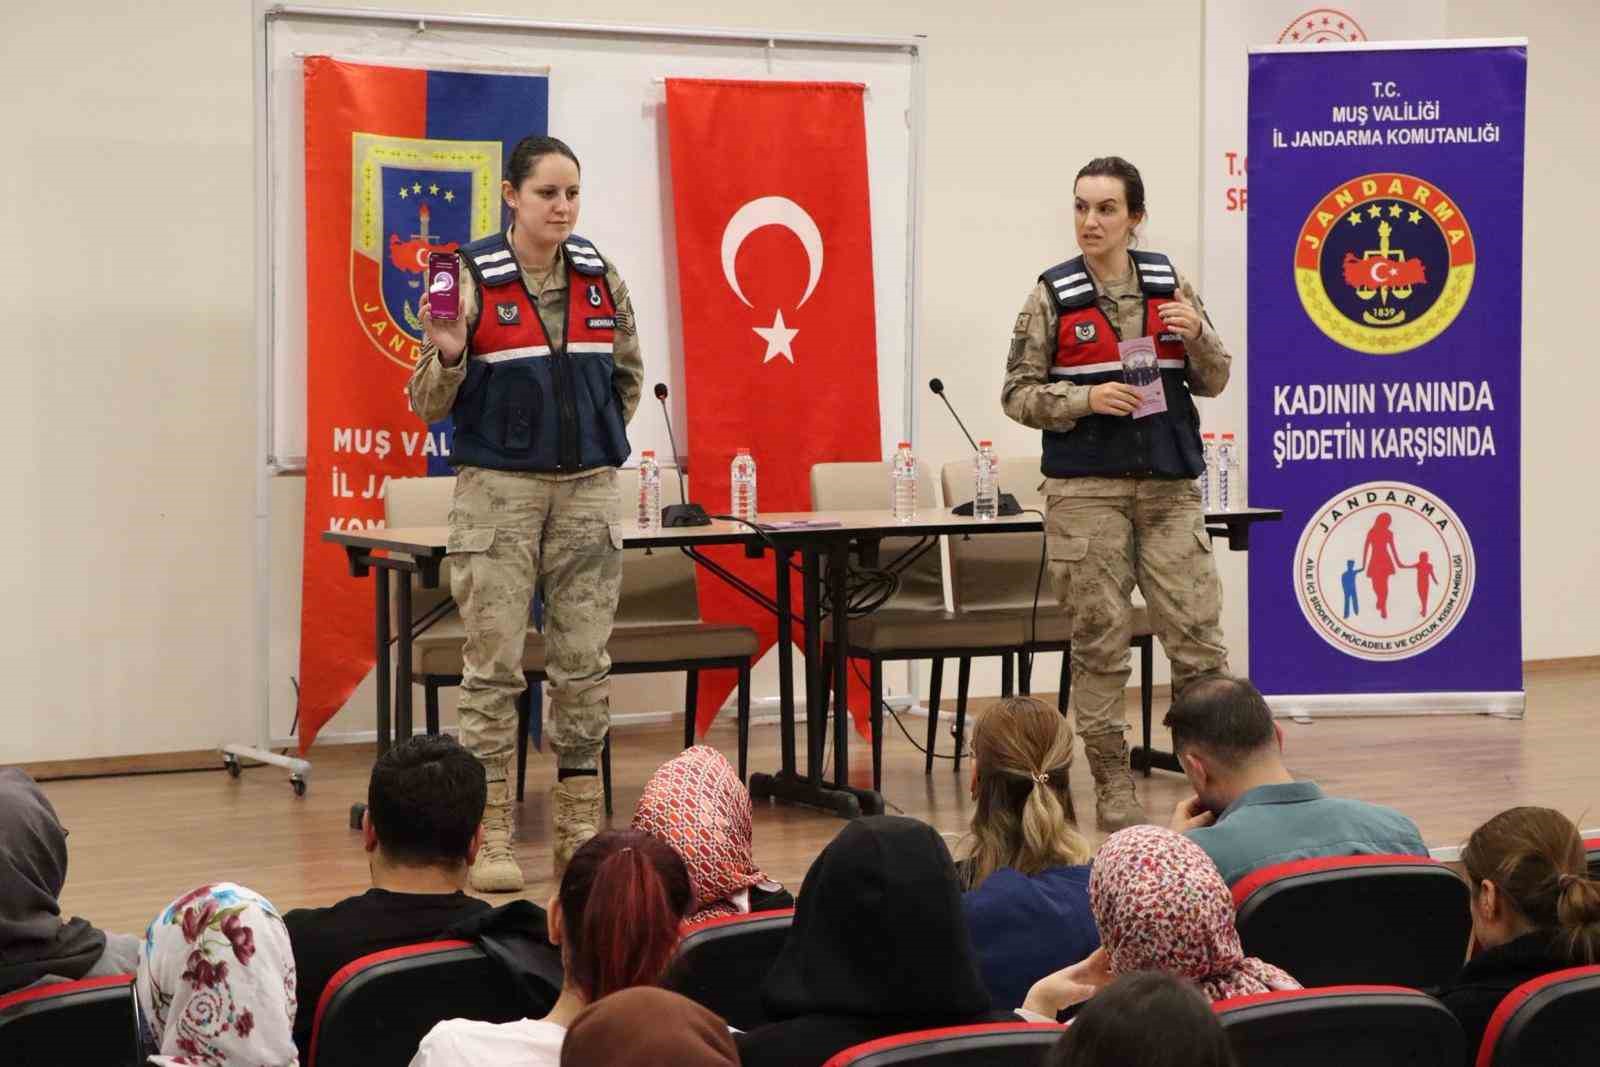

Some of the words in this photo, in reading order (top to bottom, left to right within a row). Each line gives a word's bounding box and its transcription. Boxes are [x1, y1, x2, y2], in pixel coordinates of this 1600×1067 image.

[1371, 81, 1401, 98] T.C.
[1333, 106, 1367, 126] MUŞ
[1373, 100, 1440, 121] VALİLİĞİ
[1273, 128, 1287, 148] İL
[1291, 131, 1383, 148] JANDARMA
[1387, 122, 1500, 145] KOMUTANLIĞI
[1305, 178, 1465, 250] JANDARMA
[1273, 383, 1376, 415] KADININ
[1382, 380, 1495, 413] YANINDA
[333, 427, 392, 460] MUŞ
[401, 430, 452, 457] VAL
[1273, 421, 1365, 469] ŞİDDETİN
[1371, 425, 1496, 465] KARŞISINDA
[331, 466, 354, 498] İL
[1319, 490, 1449, 534] JANDARMA
[1305, 558, 1314, 580] AİLE
[1340, 631, 1393, 650] MÜCADELE
[1394, 639, 1408, 649] VE
